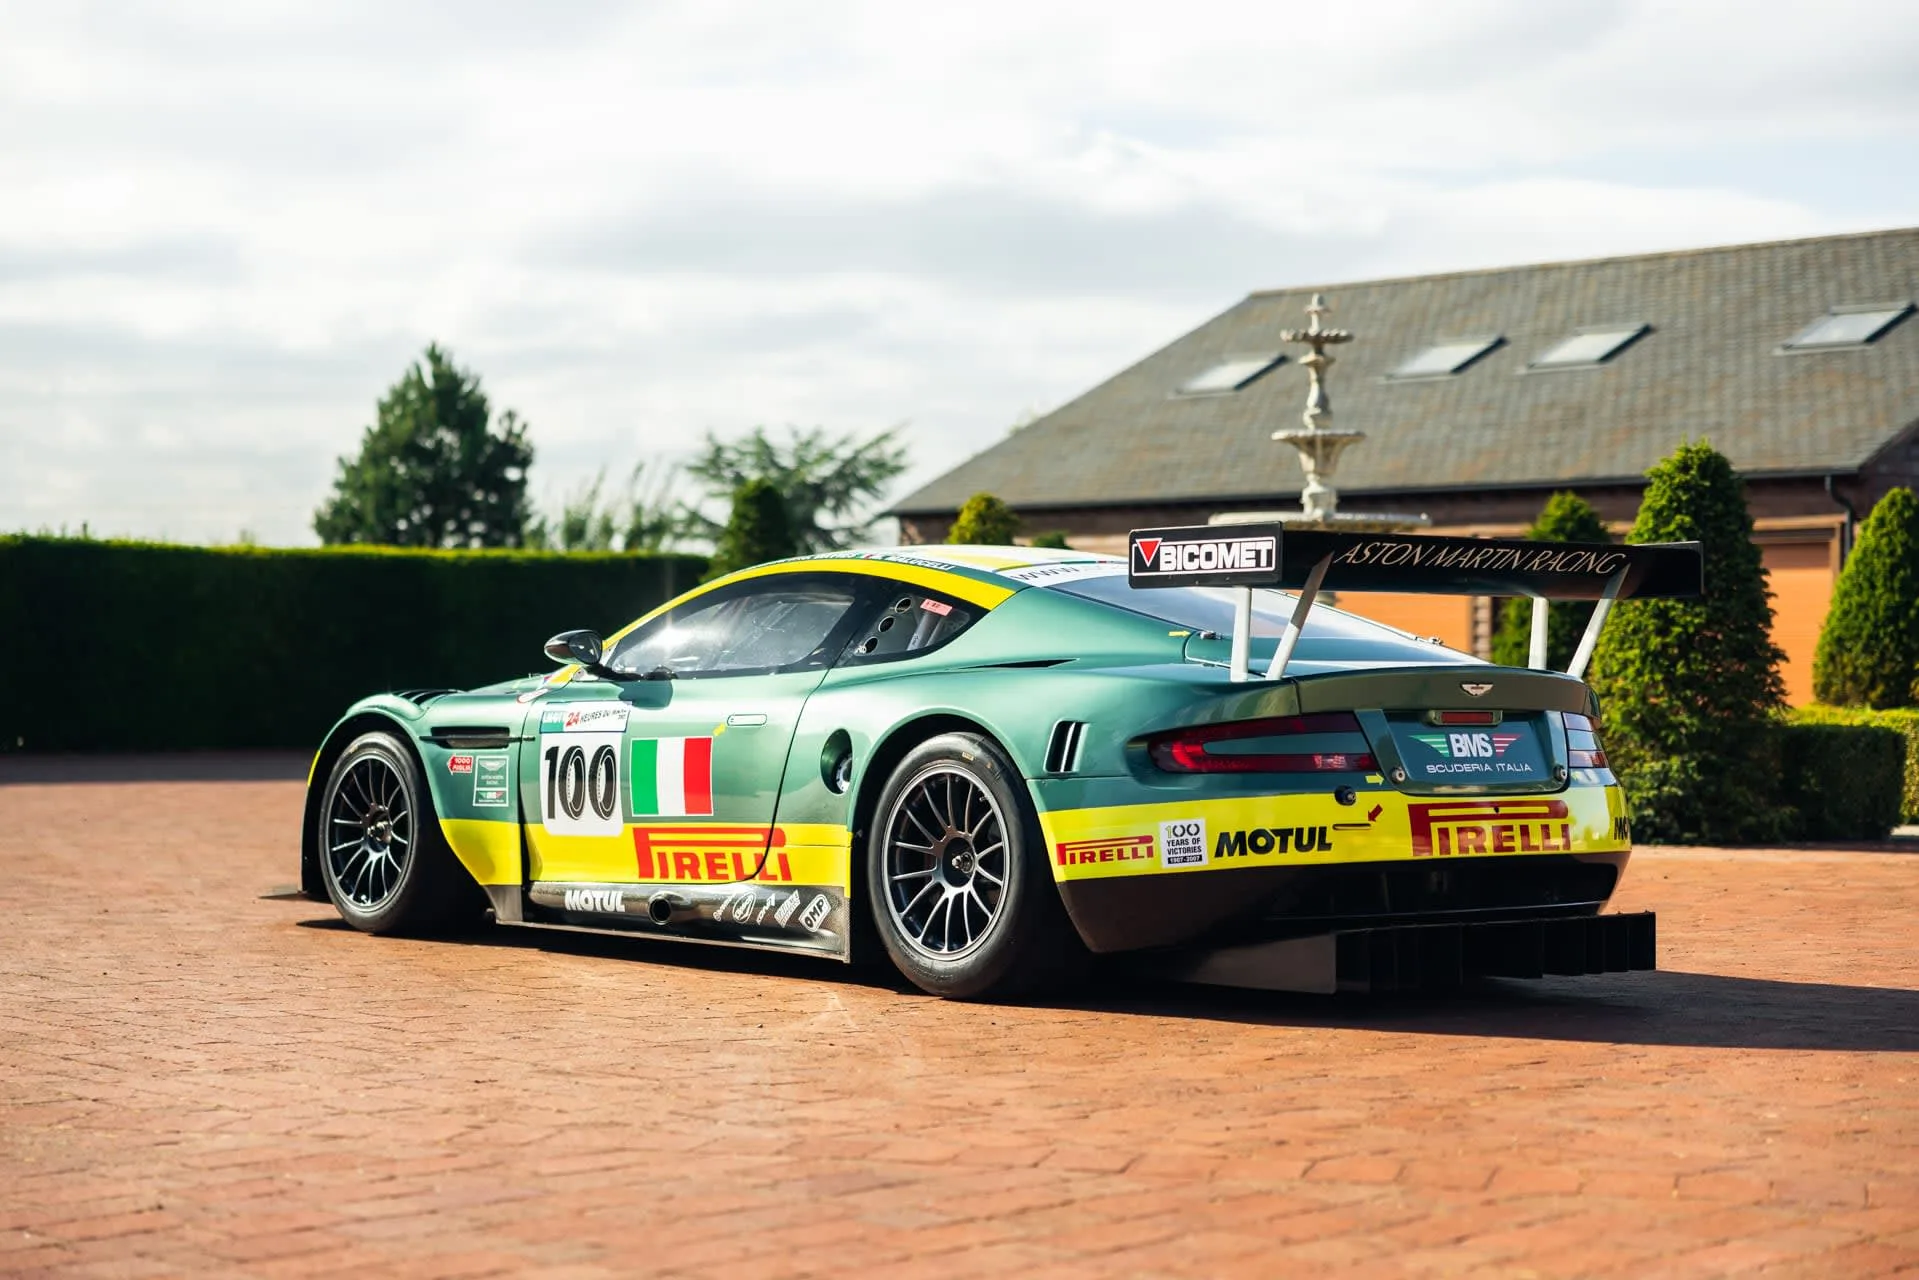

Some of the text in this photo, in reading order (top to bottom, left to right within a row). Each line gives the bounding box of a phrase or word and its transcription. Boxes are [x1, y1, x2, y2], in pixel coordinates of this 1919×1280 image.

[1159, 541, 1273, 571] BICOMET
[1333, 542, 1626, 574] ASTON MARTIN RACING
[566, 711, 580, 727] 24
[1449, 733, 1493, 758] BMS
[544, 744, 617, 821] 100
[1426, 762, 1533, 774] SCUDERIA ITALIA
[1165, 823, 1200, 838] 100
[1167, 837, 1201, 847] YEARS OF
[1214, 826, 1332, 858] MOTUL
[1408, 800, 1571, 857] PIRELLI
[633, 827, 792, 881] PIRELLI
[1056, 835, 1154, 865] PIRELLI
[1167, 846, 1202, 855] VICTORIES
[564, 889, 625, 912] MOTUL
[804, 898, 824, 928] OMP
